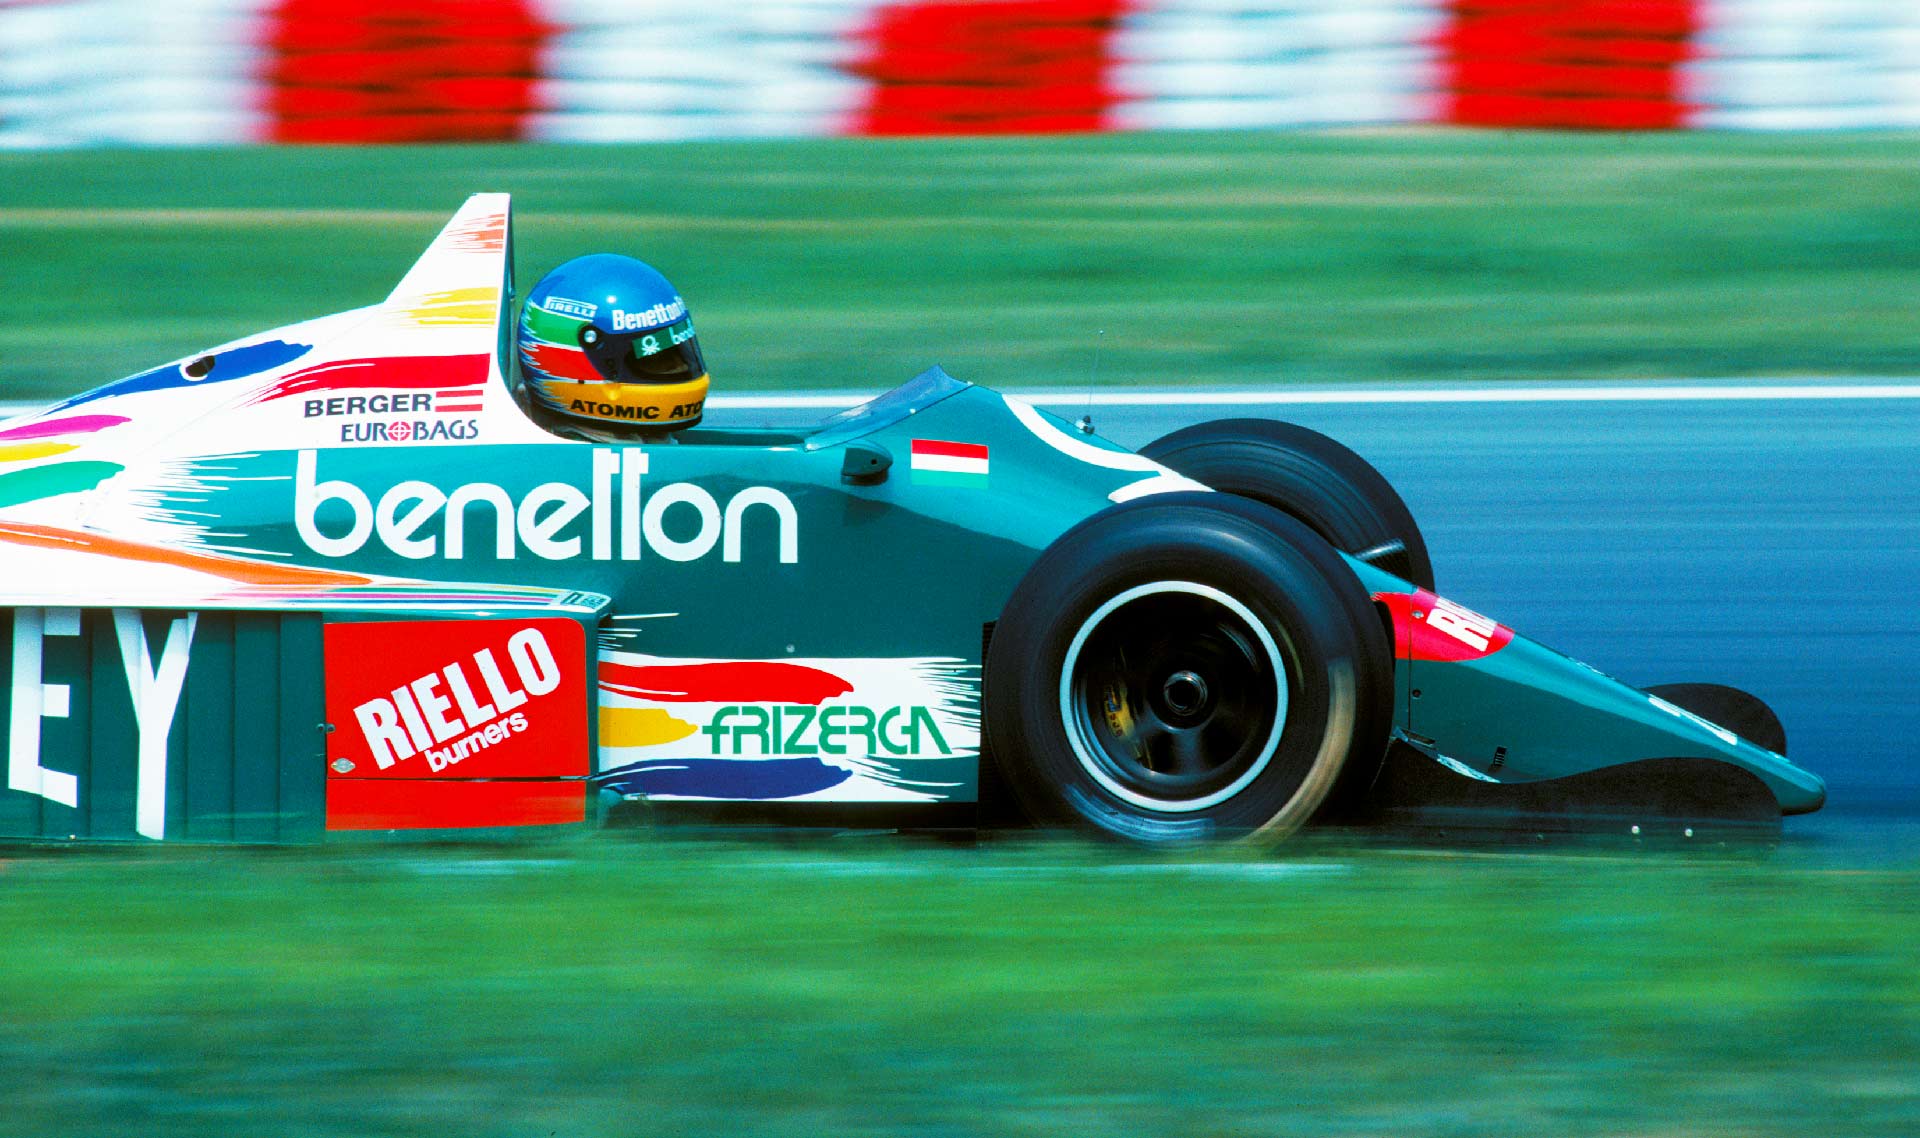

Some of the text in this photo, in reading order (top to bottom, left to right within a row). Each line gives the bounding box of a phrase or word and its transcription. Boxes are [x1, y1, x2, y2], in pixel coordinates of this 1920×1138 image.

[544, 296, 598, 318] PIRELLI
[304, 394, 432, 418] BERGER
[570, 397, 705, 419] ATOMIC ATO
[341, 420, 479, 442] EUROBAGS
[295, 447, 798, 563] benetton
[353, 628, 561, 770] RIELLO
[425, 712, 528, 772] burners
